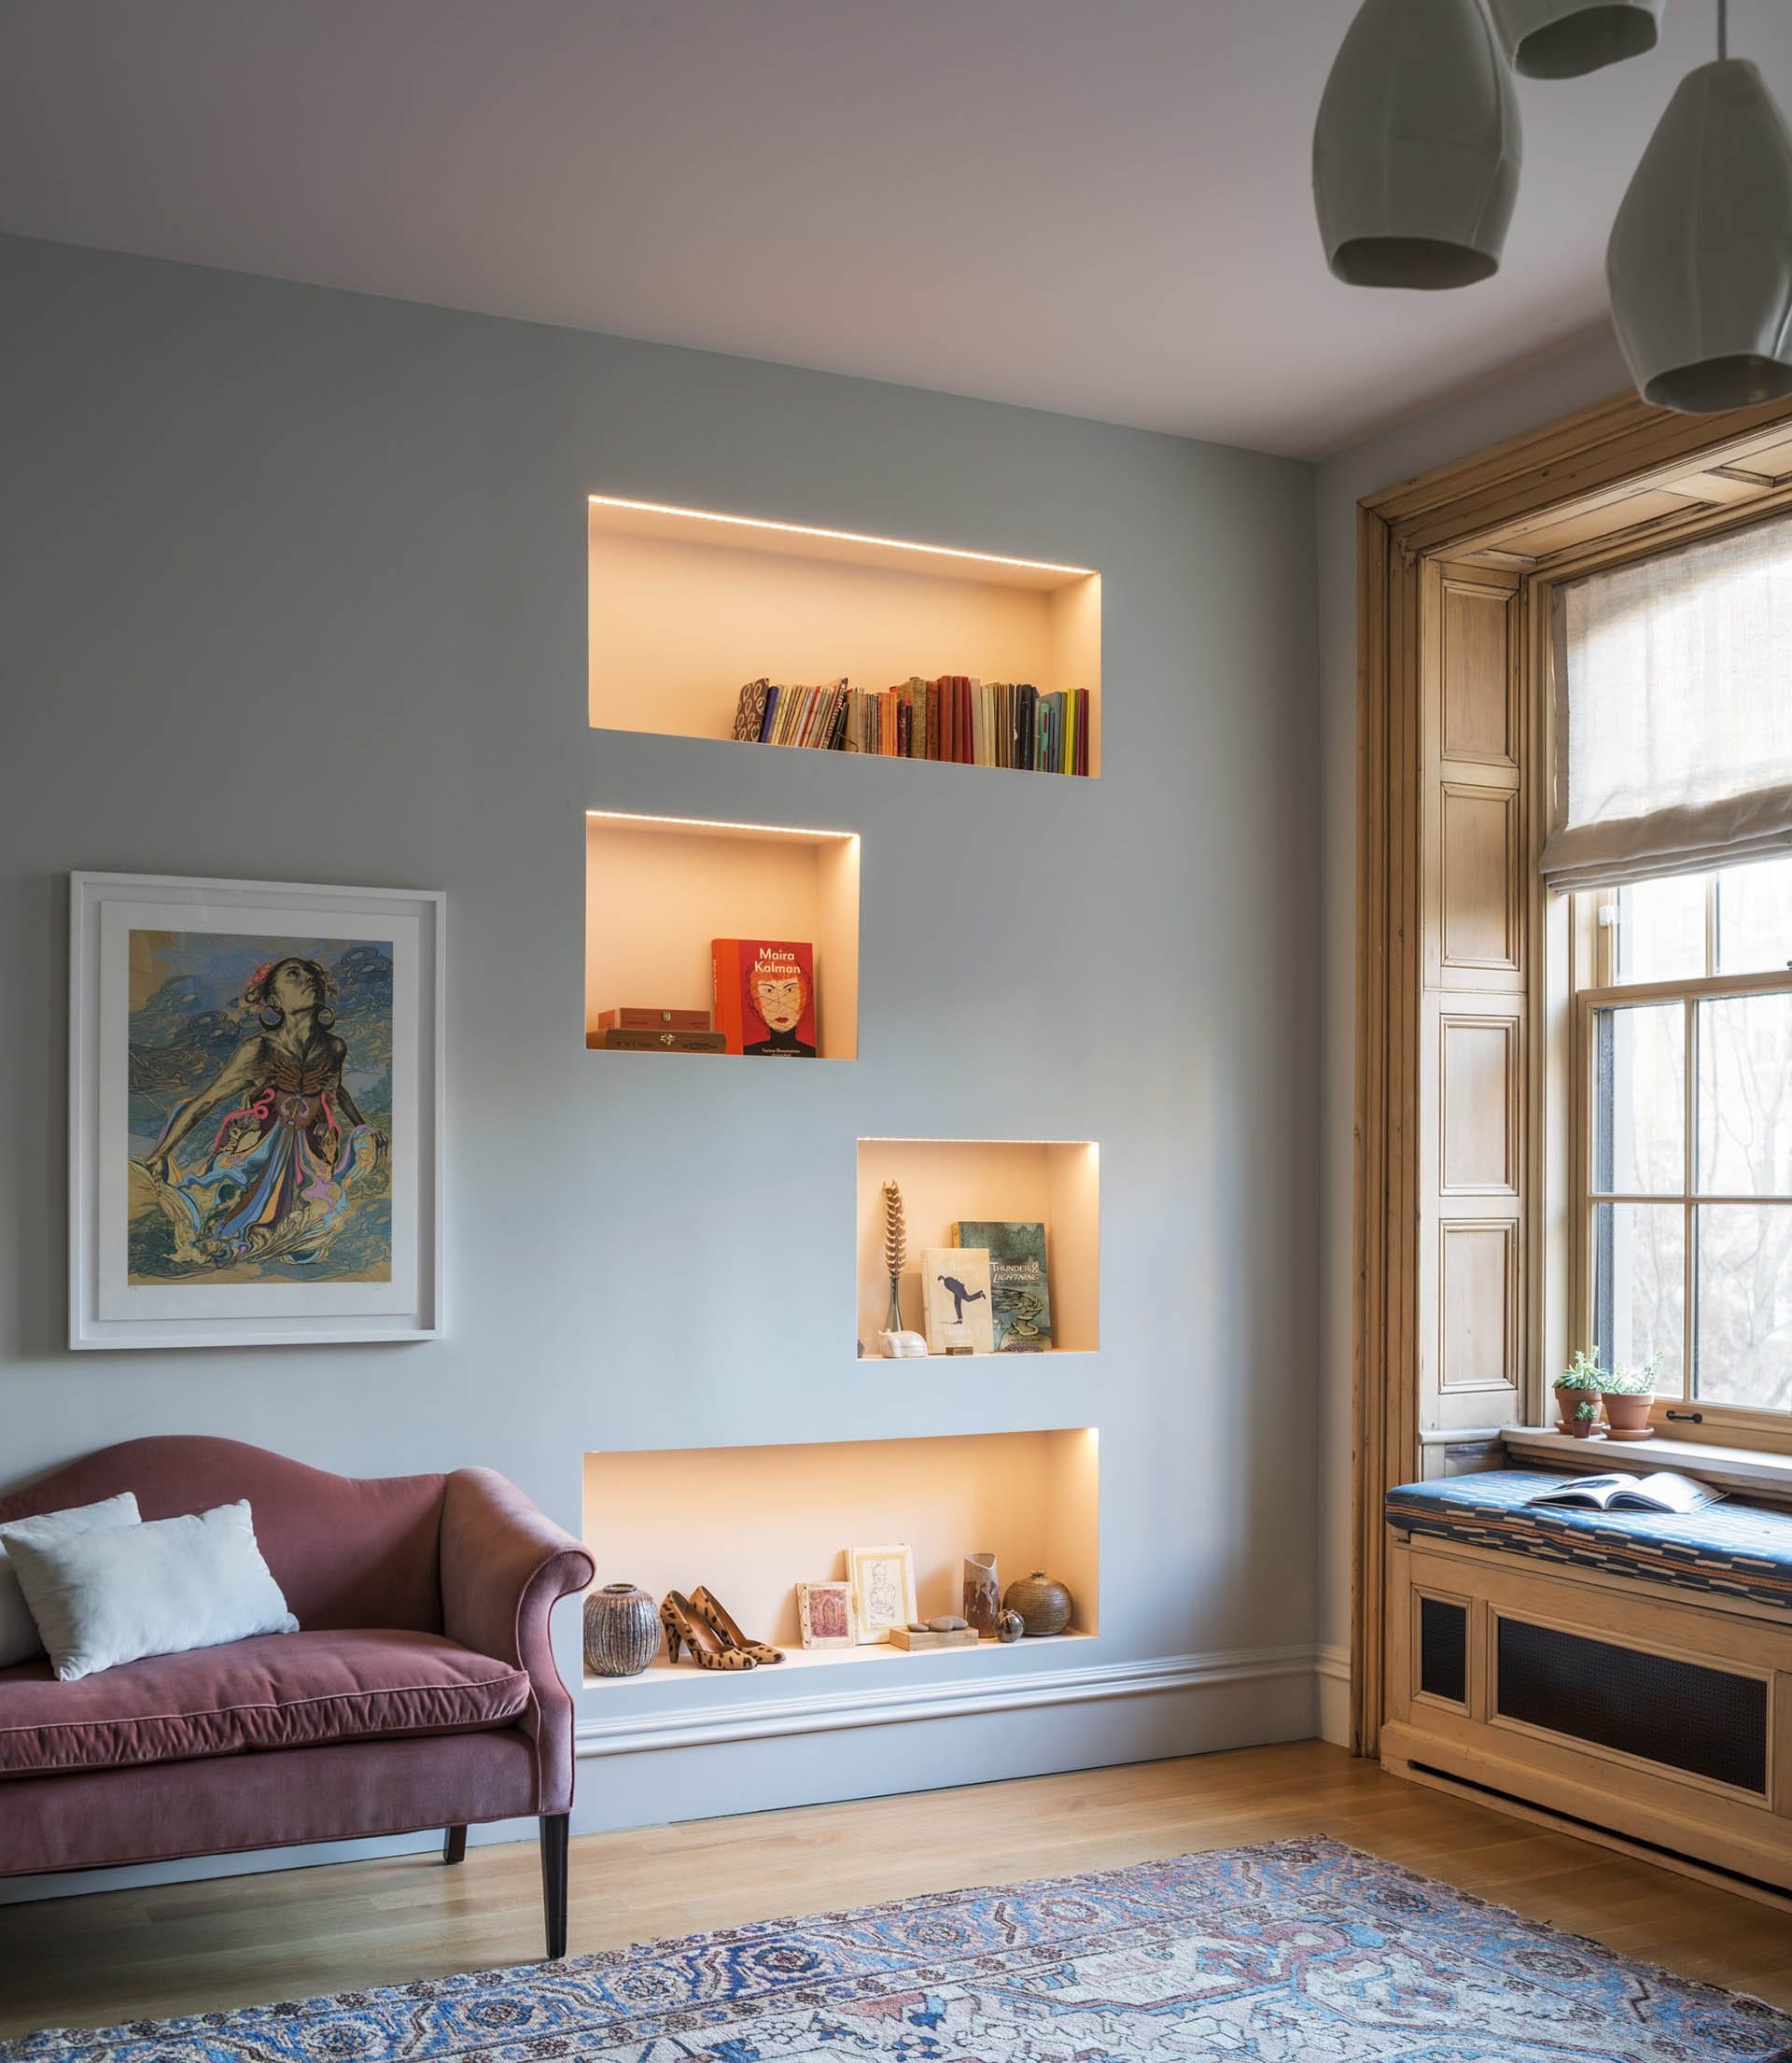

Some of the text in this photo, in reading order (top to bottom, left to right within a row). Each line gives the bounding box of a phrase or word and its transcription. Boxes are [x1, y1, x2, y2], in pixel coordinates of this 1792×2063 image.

[759, 948, 795, 961] Maira
[754, 960, 801, 975] Kalman
[990, 1262, 1030, 1272] THUNDER
[1031, 1260, 1040, 1273] &
[993, 1272, 1040, 1284] LIGHTNING
